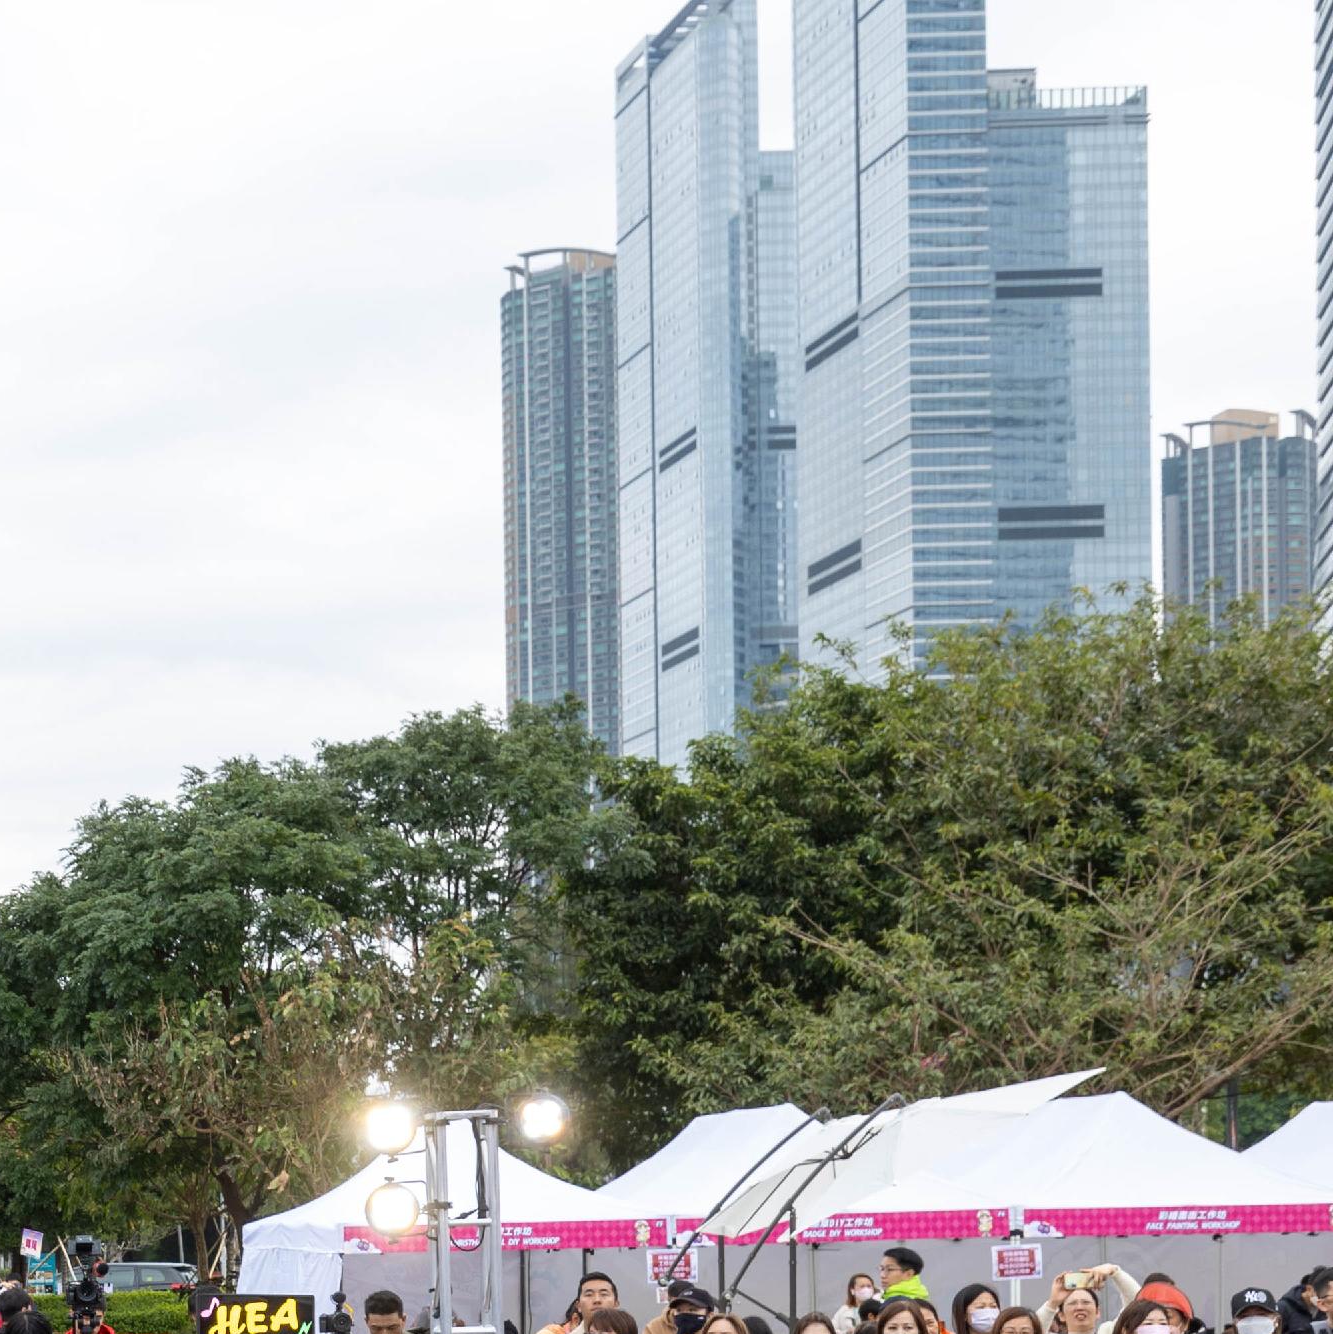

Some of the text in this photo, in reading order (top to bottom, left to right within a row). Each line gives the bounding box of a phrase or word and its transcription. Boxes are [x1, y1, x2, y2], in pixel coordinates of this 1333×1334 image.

[1201, 1220, 1241, 1229] WORKSHOP
[803, 1228, 883, 1238] BADGE DIY WORKSHOP
[508, 1238, 520, 1246] DIY
[523, 1237, 560, 1246] WORKSHOP
